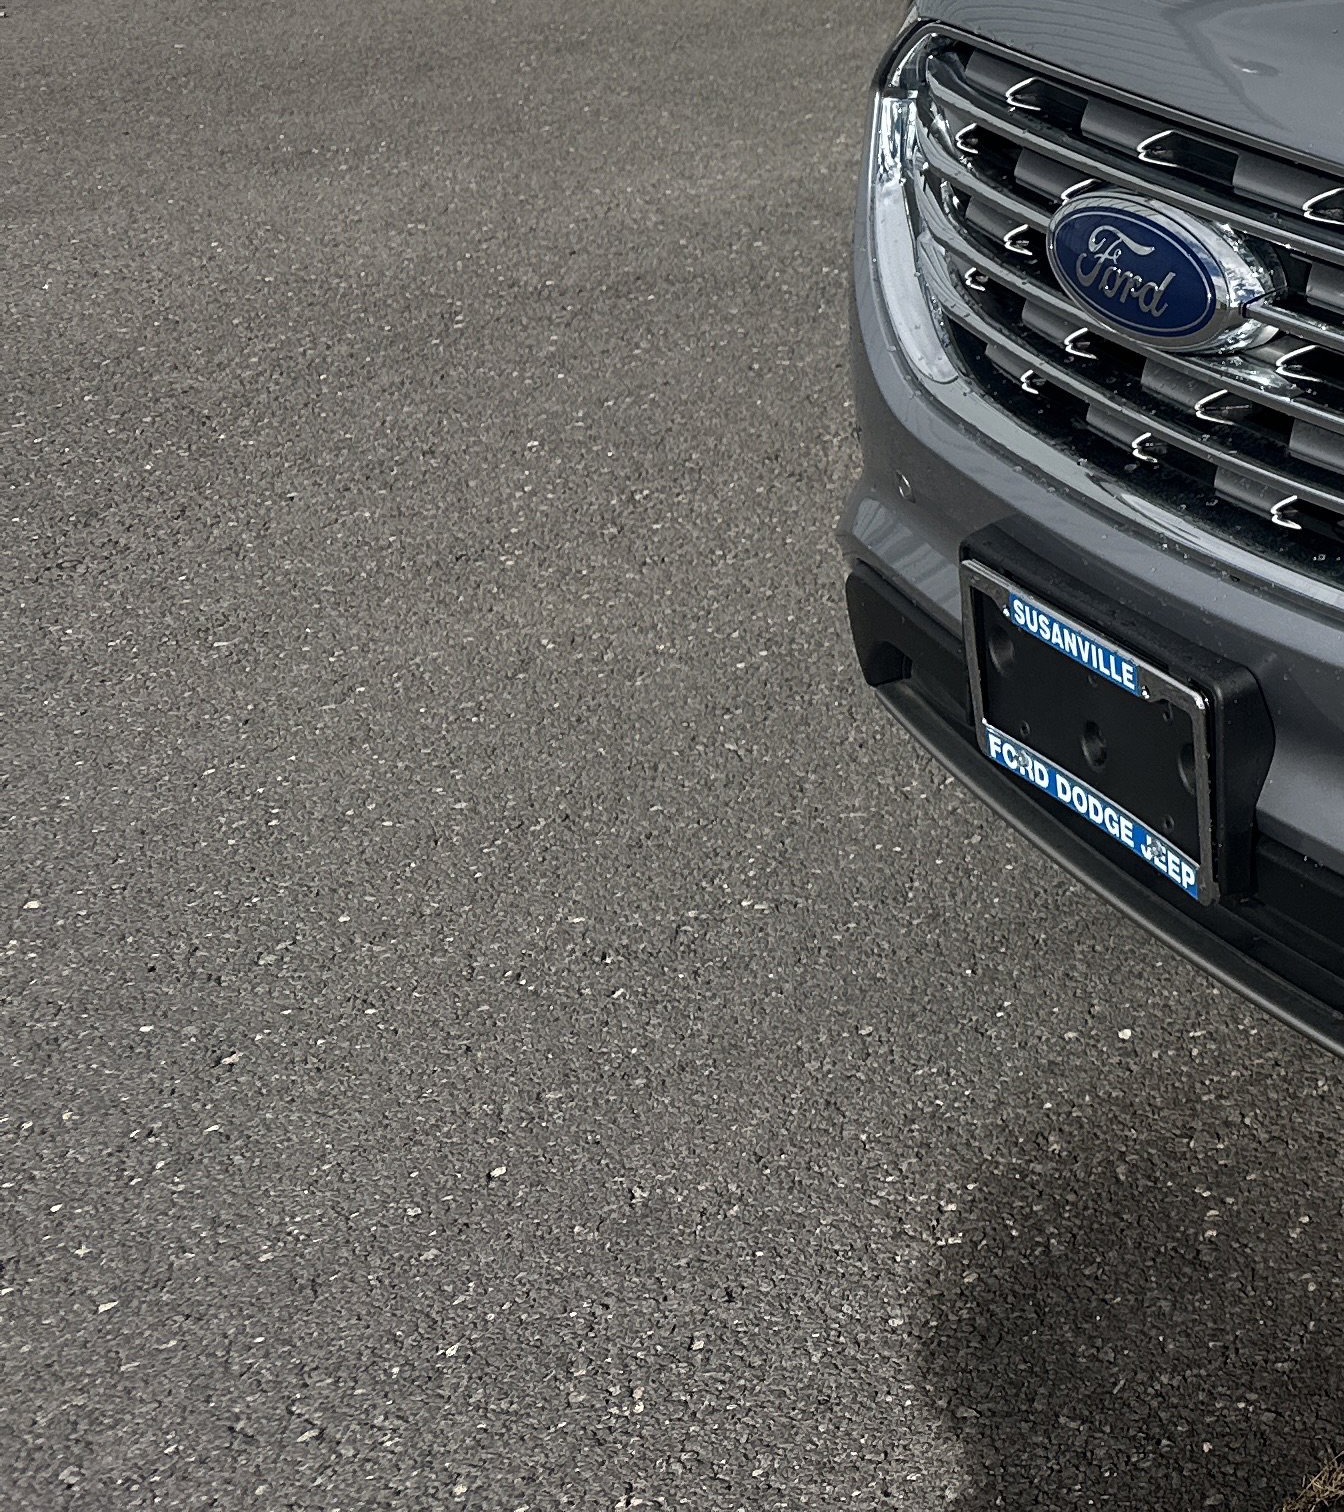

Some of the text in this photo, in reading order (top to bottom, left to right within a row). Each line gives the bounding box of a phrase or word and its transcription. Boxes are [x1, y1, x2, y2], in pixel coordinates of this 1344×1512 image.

[1075, 225, 1176, 317] Ford
[1013, 599, 1135, 690] SUSANVILLE
[988, 733, 1049, 788] FORD
[1055, 774, 1135, 849] DODGE
